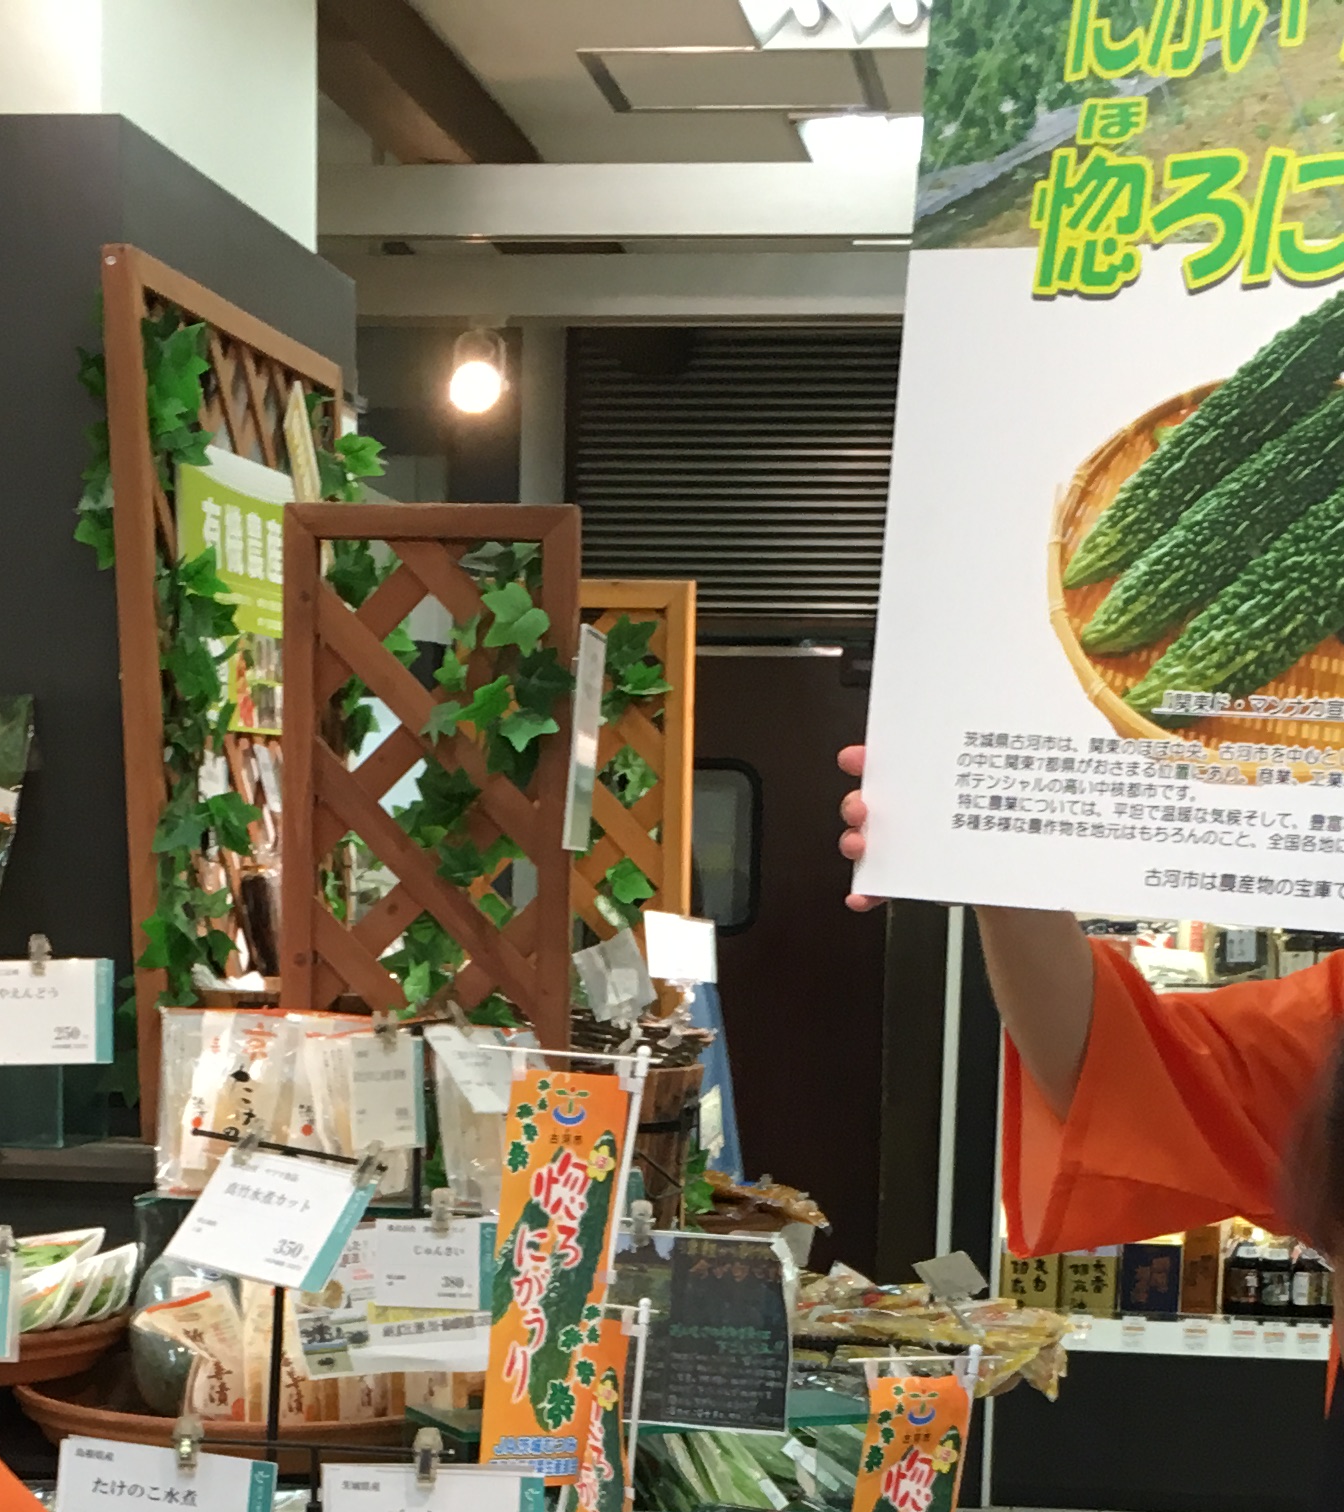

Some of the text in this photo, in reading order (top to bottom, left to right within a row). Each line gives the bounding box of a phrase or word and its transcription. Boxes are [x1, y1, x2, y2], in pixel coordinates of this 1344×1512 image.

[1076, 97, 1148, 146] ほ
[502, 1221, 550, 1402] にがうり
[91, 1477, 198, 1508] たけのこ水煮
